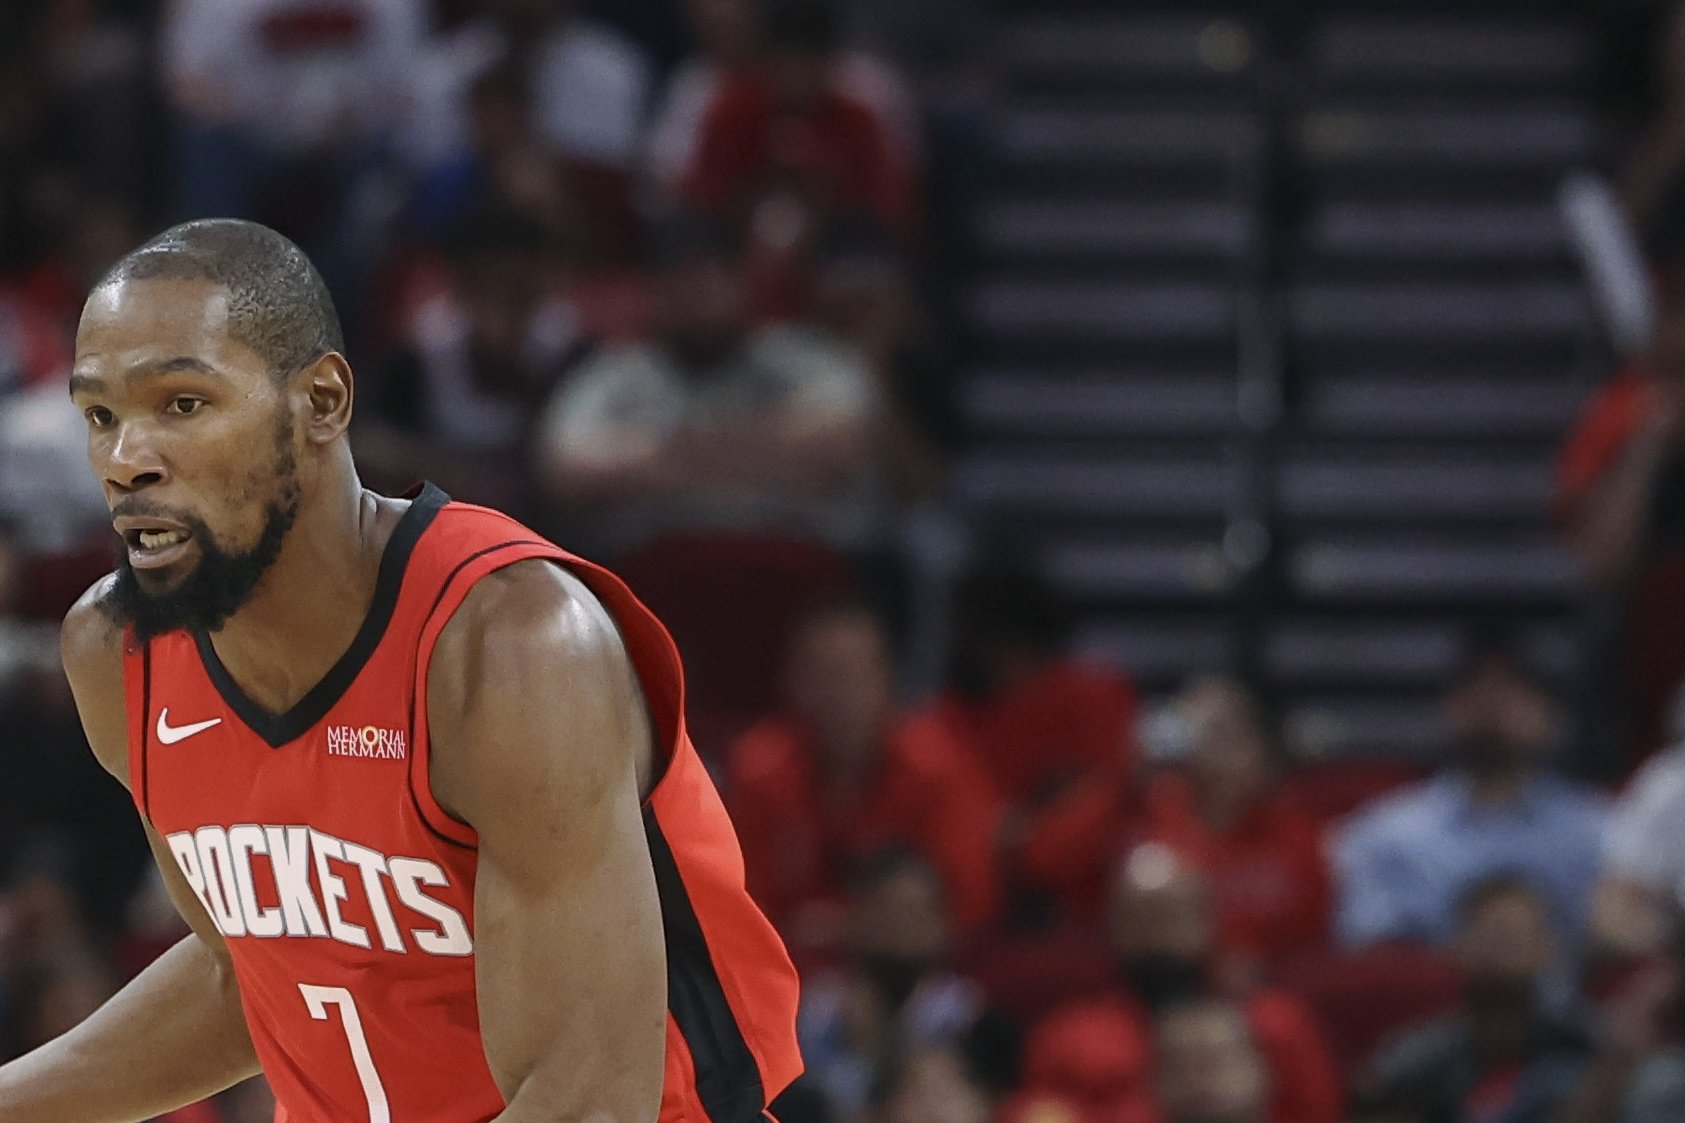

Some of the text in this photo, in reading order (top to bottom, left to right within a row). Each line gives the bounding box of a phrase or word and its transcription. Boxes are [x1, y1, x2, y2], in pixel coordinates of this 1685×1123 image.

[327, 725, 406, 747] MEMORIAL
[328, 739, 406, 760] HERMANN
[165, 824, 476, 957] ROCKETS
